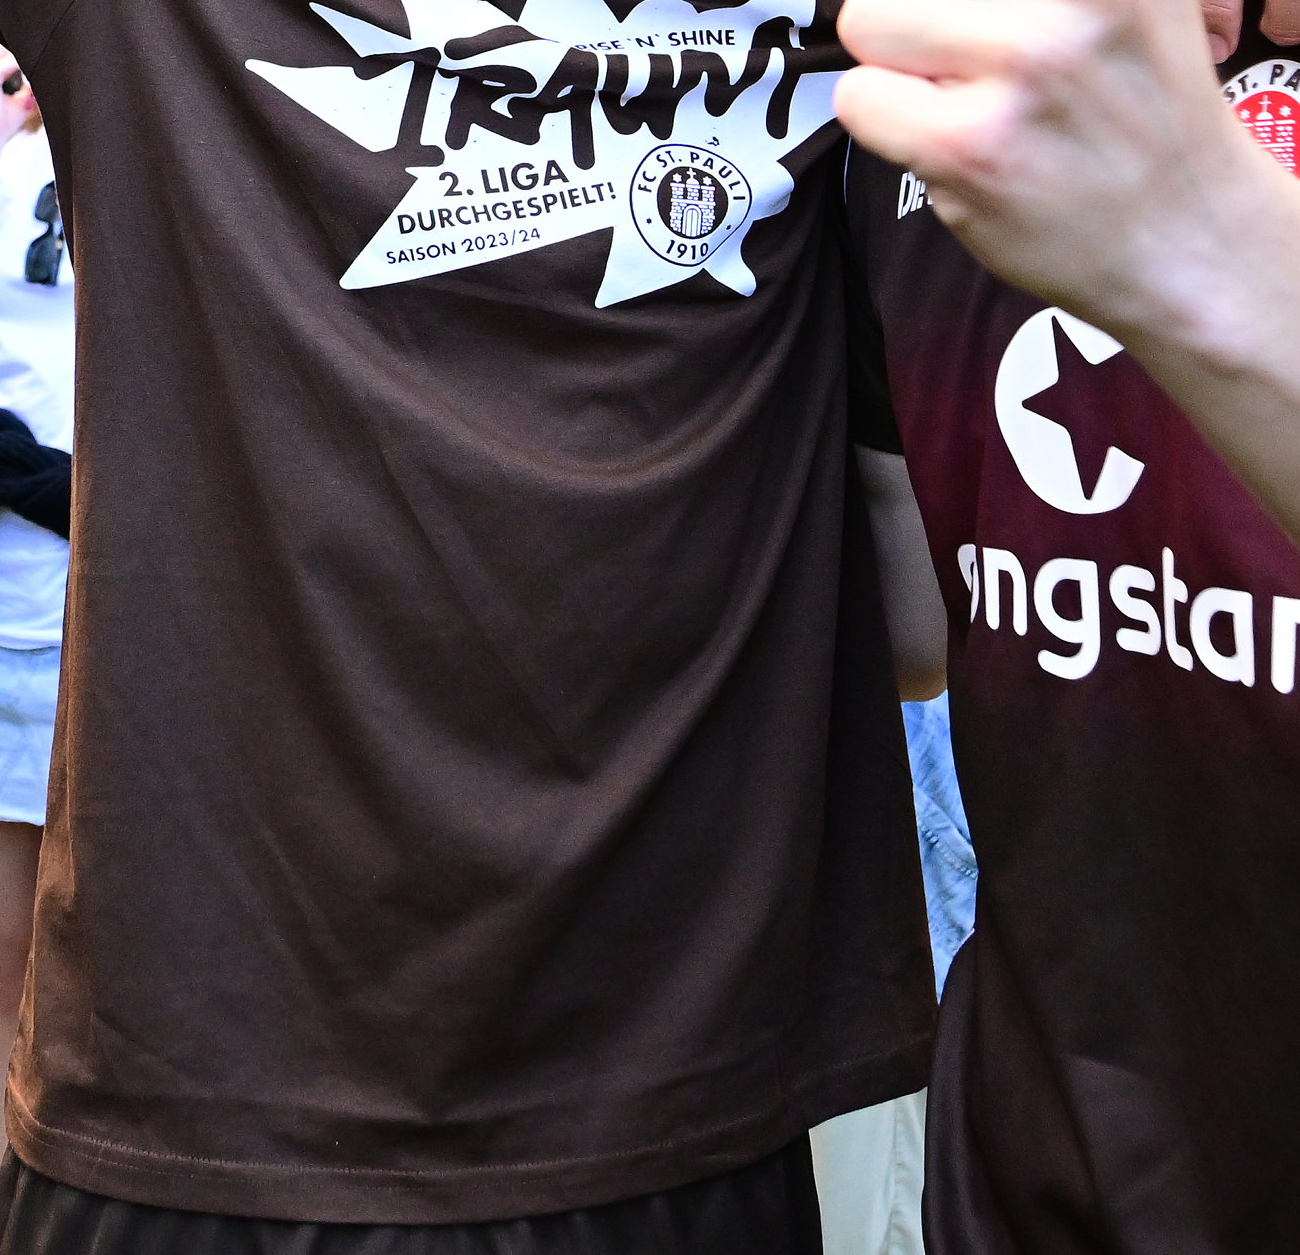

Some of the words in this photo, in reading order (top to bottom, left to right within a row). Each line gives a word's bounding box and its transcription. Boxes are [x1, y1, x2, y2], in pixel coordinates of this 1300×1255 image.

[667, 29, 736, 47] SHINE
[438, 171, 475, 197] 2.
[480, 159, 571, 195] LIGA
[637, 170, 657, 193] FC
[655, 150, 683, 168] ST.
[689, 151, 746, 201] PAULI
[397, 181, 618, 235] DURCHGESPIELT!
[386, 241, 457, 265] SAISON
[461, 227, 541, 253] 2023/24
[666, 239, 709, 260] 1910
